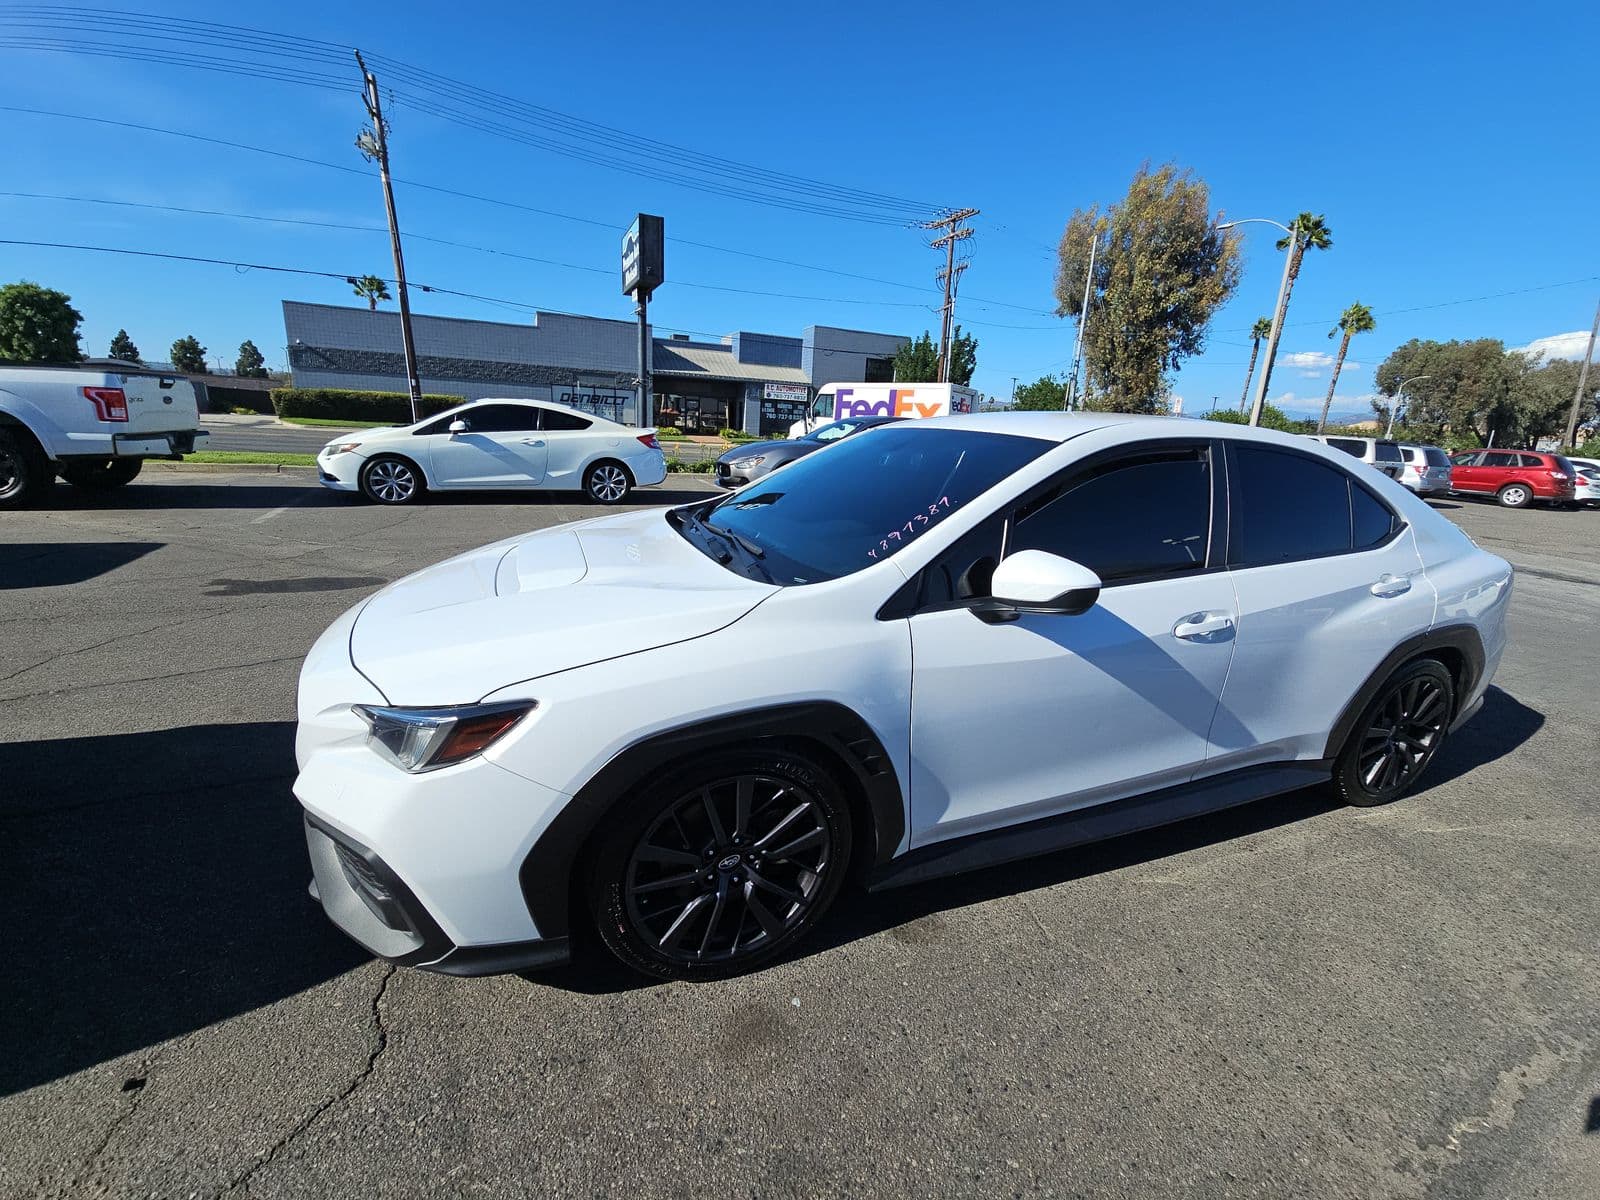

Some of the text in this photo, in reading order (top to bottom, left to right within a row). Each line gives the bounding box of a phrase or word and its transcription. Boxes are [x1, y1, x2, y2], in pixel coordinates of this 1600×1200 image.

[776, 385, 807, 394] AUTOMOTIVE
[834, 388, 943, 420] FedEx
[951, 396, 971, 414] edEx
